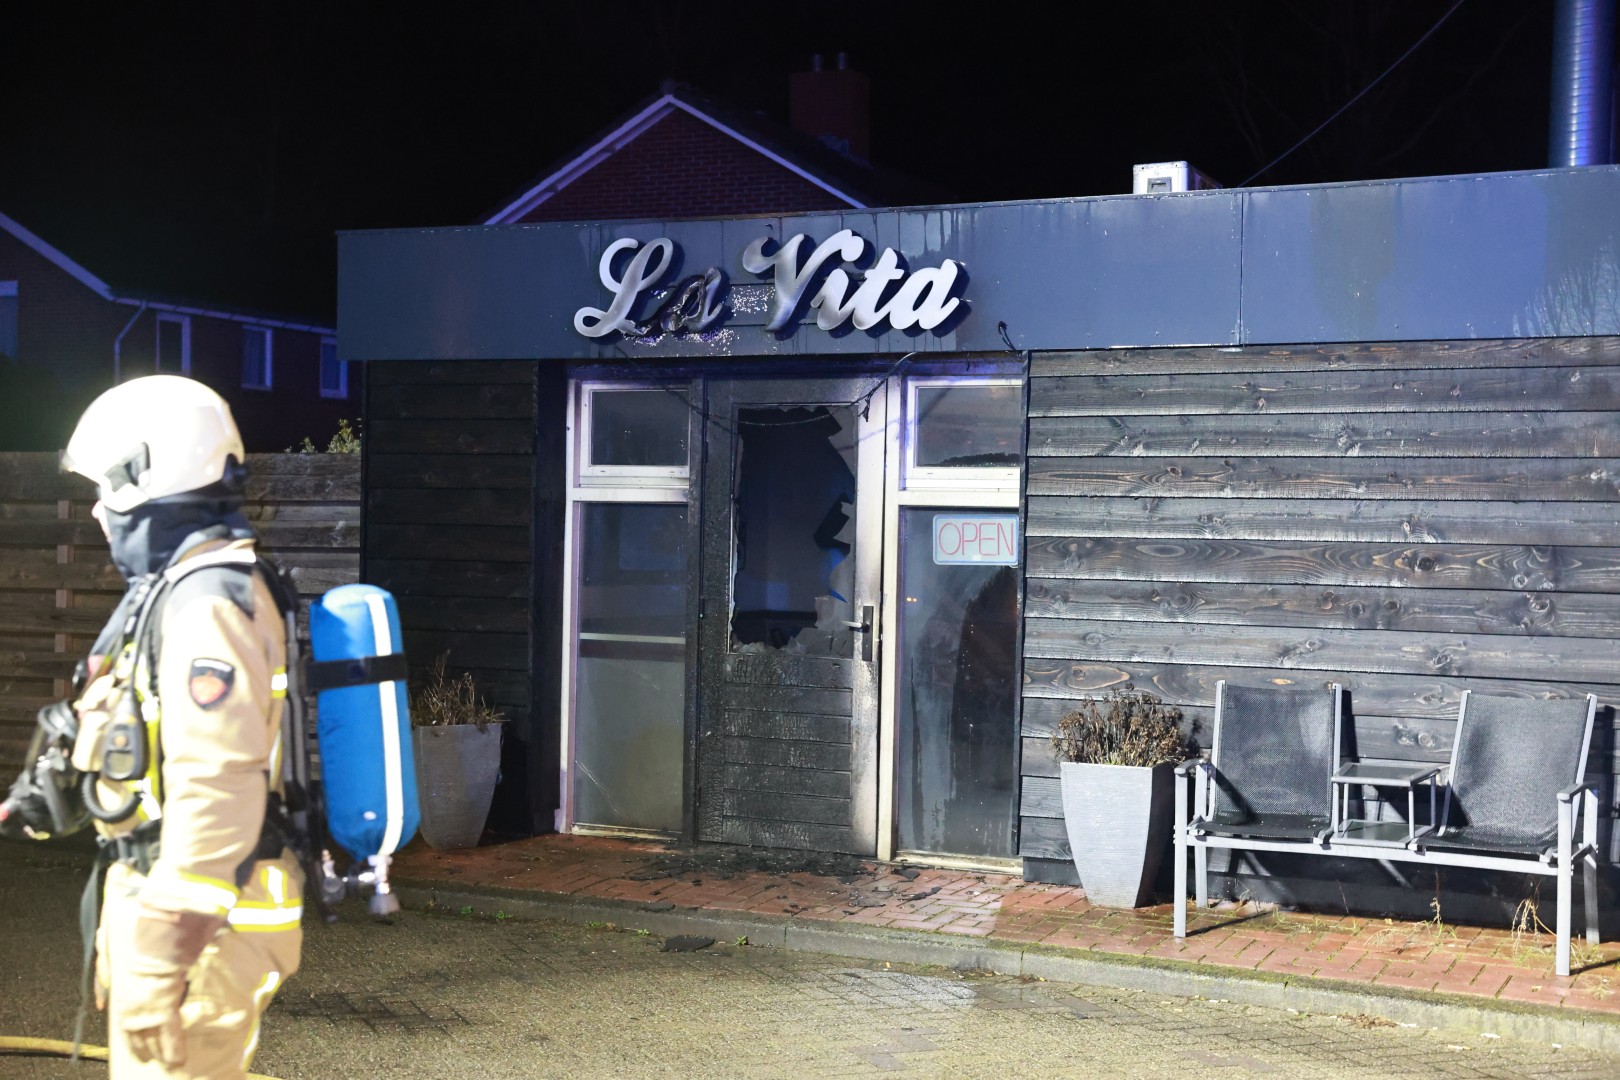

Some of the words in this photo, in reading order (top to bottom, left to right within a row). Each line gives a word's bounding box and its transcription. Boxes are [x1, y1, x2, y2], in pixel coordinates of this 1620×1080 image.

[573, 237, 723, 337] La
[742, 229, 960, 331] Vita
[939, 522, 1013, 556] OPEN
